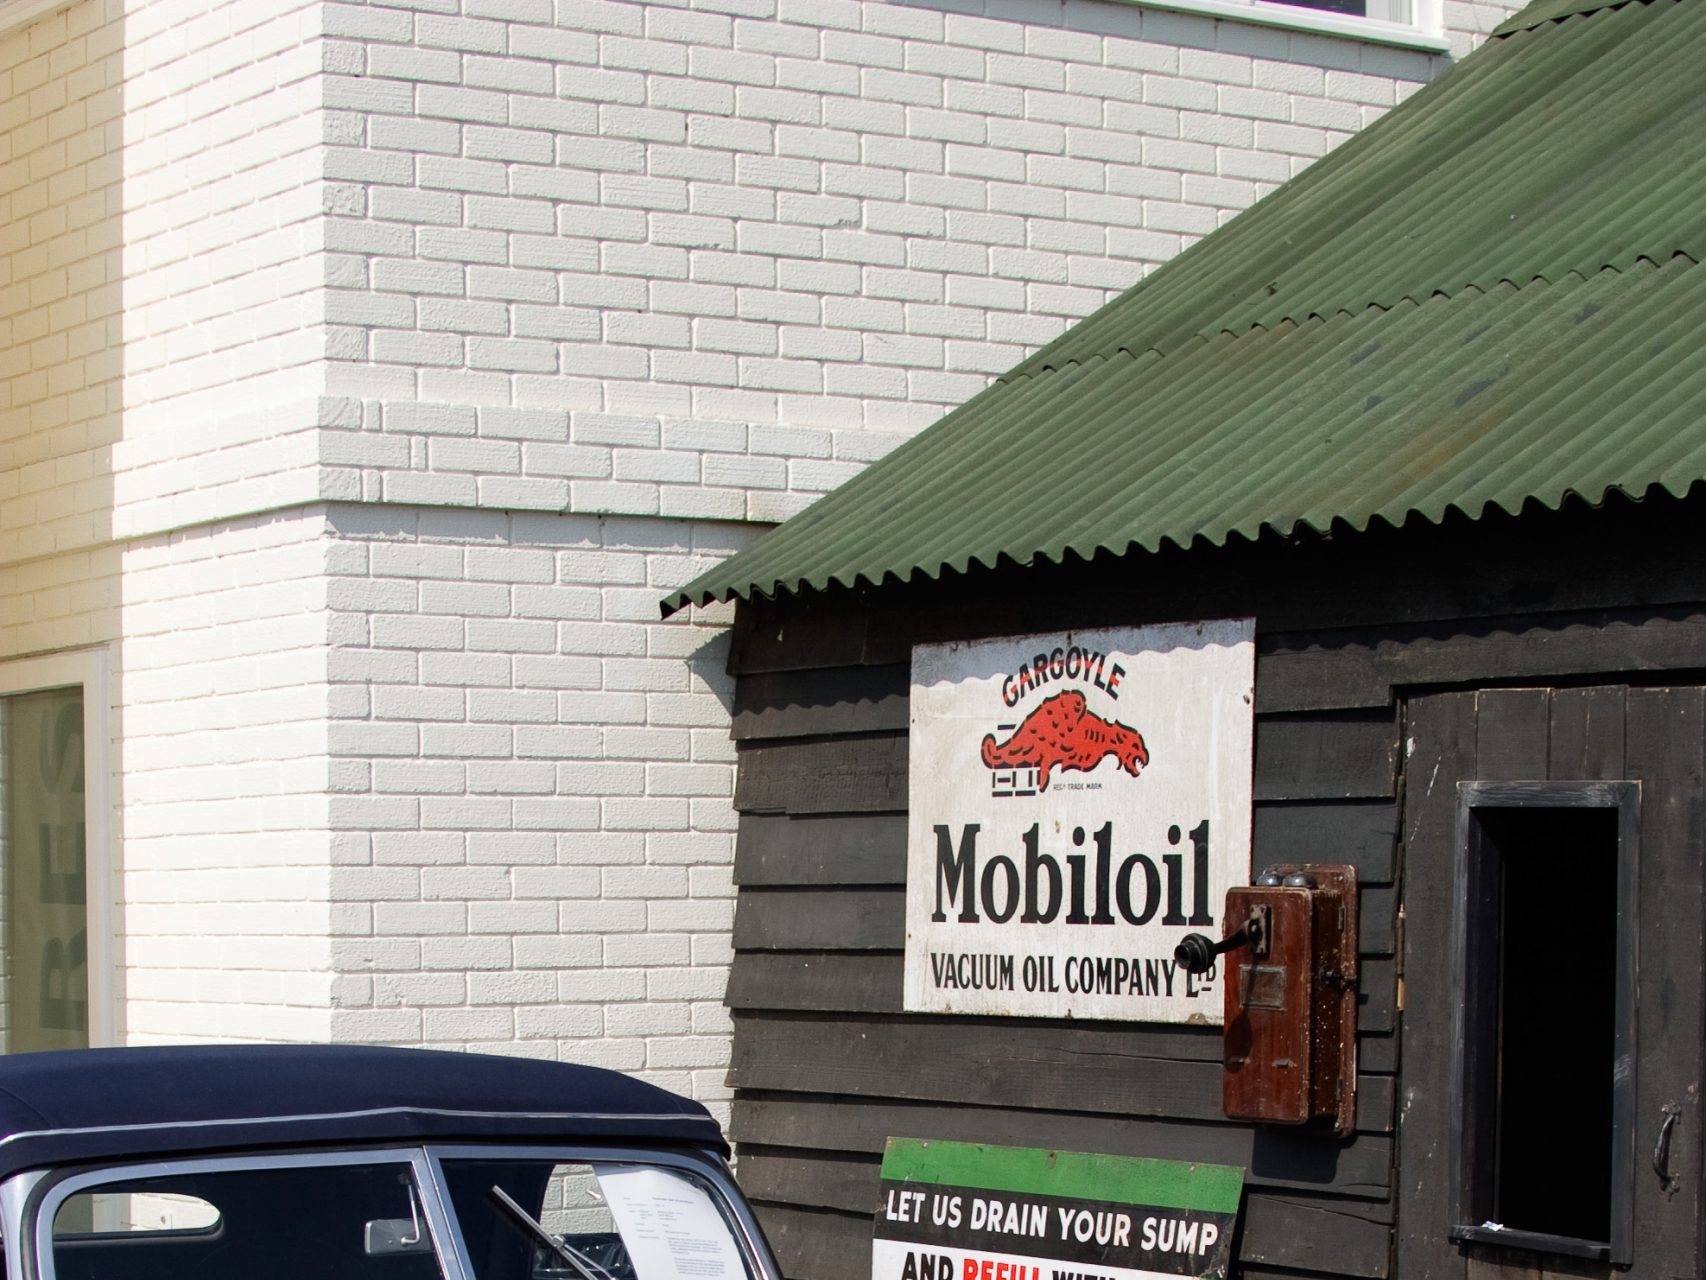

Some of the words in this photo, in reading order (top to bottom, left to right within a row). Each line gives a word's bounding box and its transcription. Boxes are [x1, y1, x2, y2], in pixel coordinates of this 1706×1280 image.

[1002, 646, 1126, 708] GARGOYLE
[1068, 783, 1084, 791] TRADE
[1086, 782, 1102, 790] MARK
[931, 819, 1214, 926] Mobiloil
[930, 953, 1014, 991] VACUUM
[1023, 955, 1059, 993] OIL
[1065, 957, 1177, 998] COMPANY
[886, 1189, 926, 1223] LET
[932, 1195, 962, 1229] US
[970, 1197, 1048, 1239] DRAIN
[1058, 1208, 1131, 1247] YOUR
[1141, 1216, 1218, 1256] SUMP
